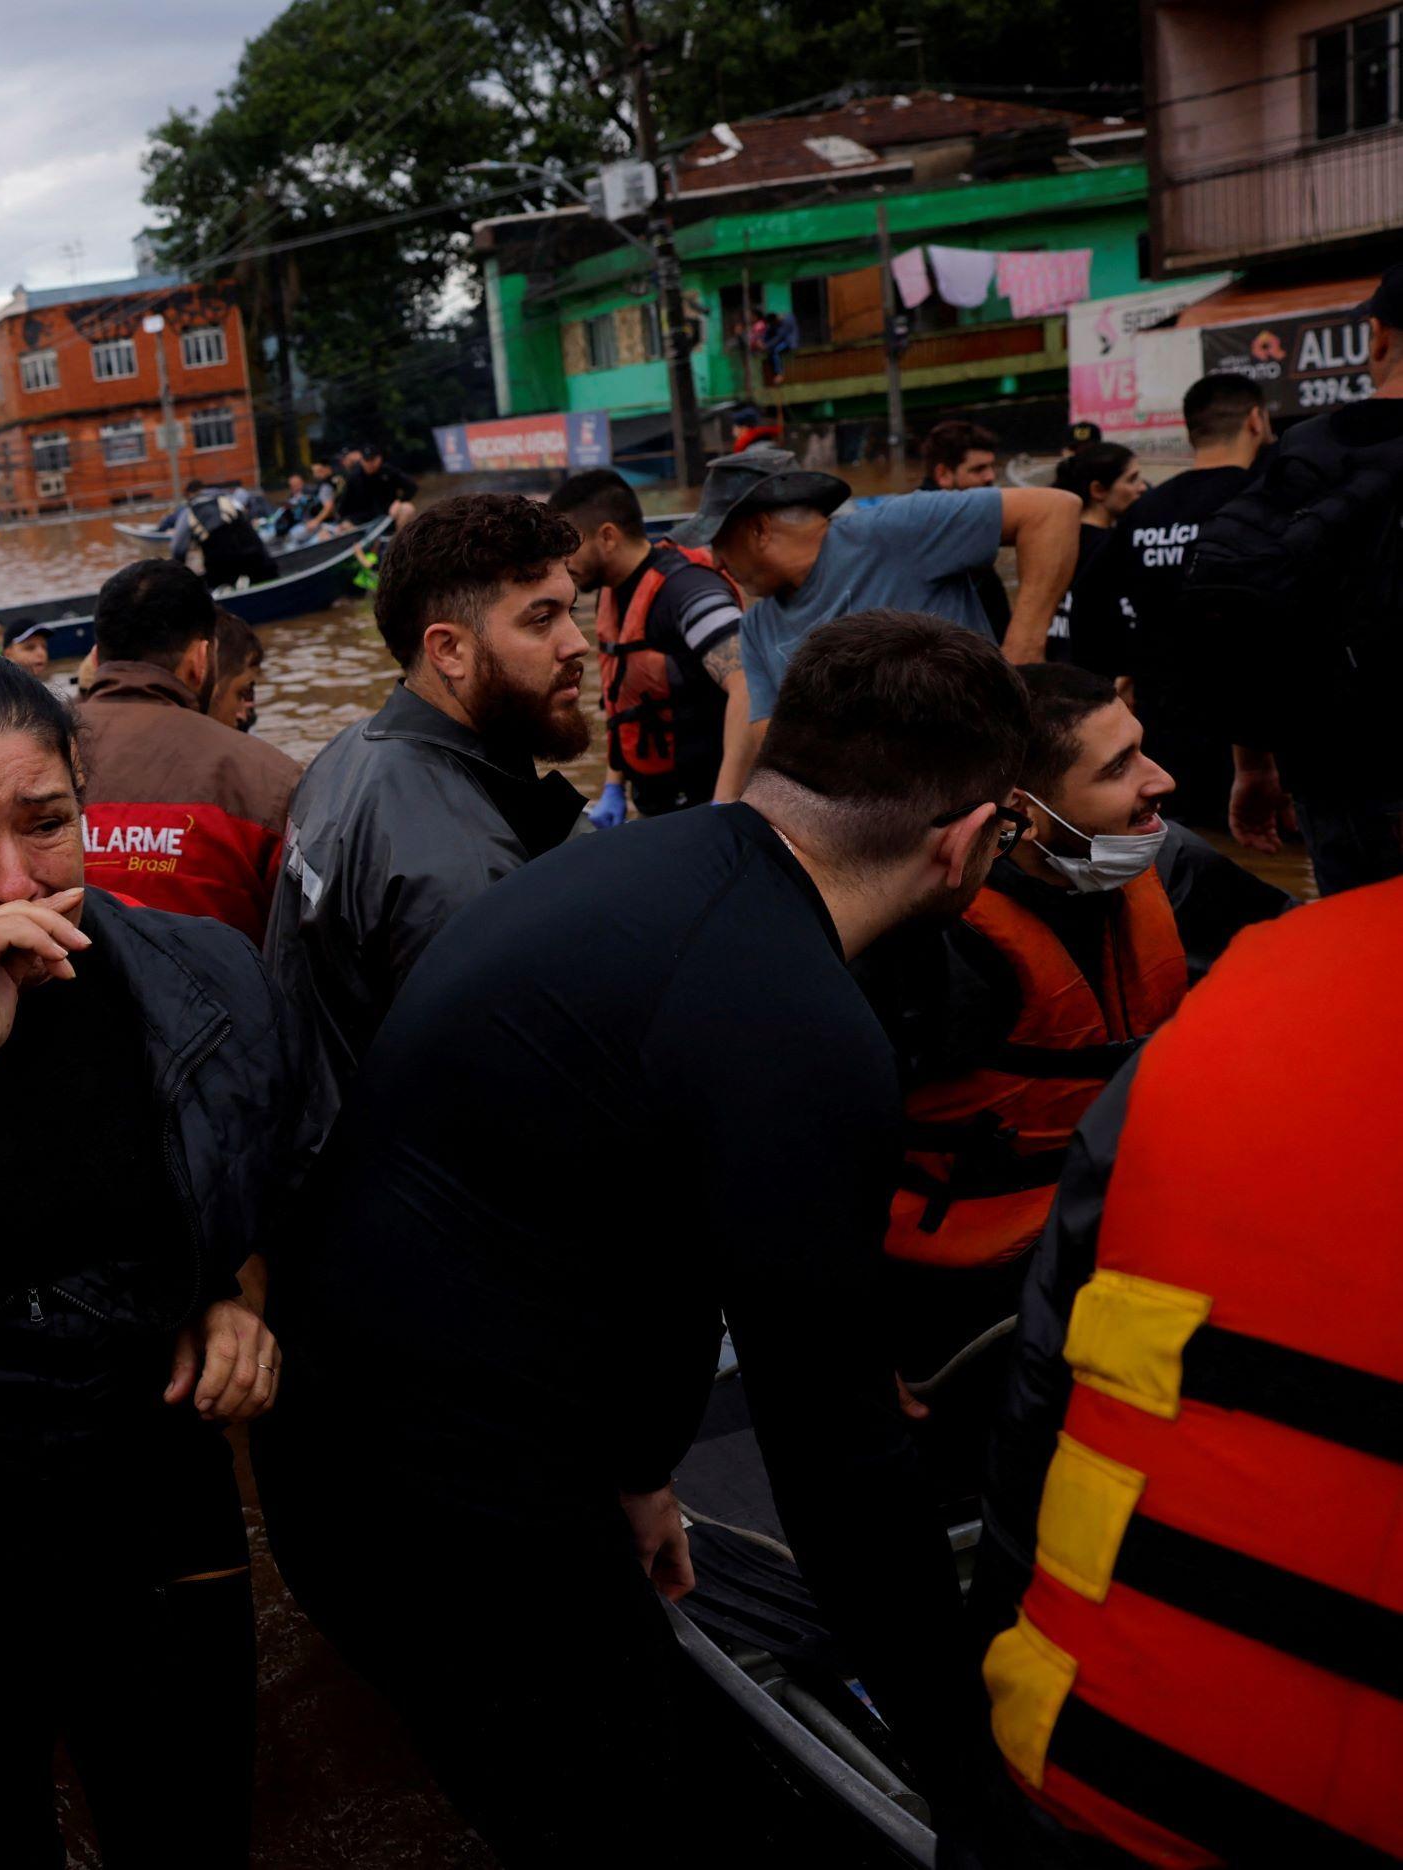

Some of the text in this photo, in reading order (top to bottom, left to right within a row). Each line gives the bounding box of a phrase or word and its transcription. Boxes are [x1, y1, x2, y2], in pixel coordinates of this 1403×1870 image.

[1298, 322, 1371, 372] ALU
[1300, 373, 1377, 407] 3394.3
[127, 856, 177, 874] Brasil
